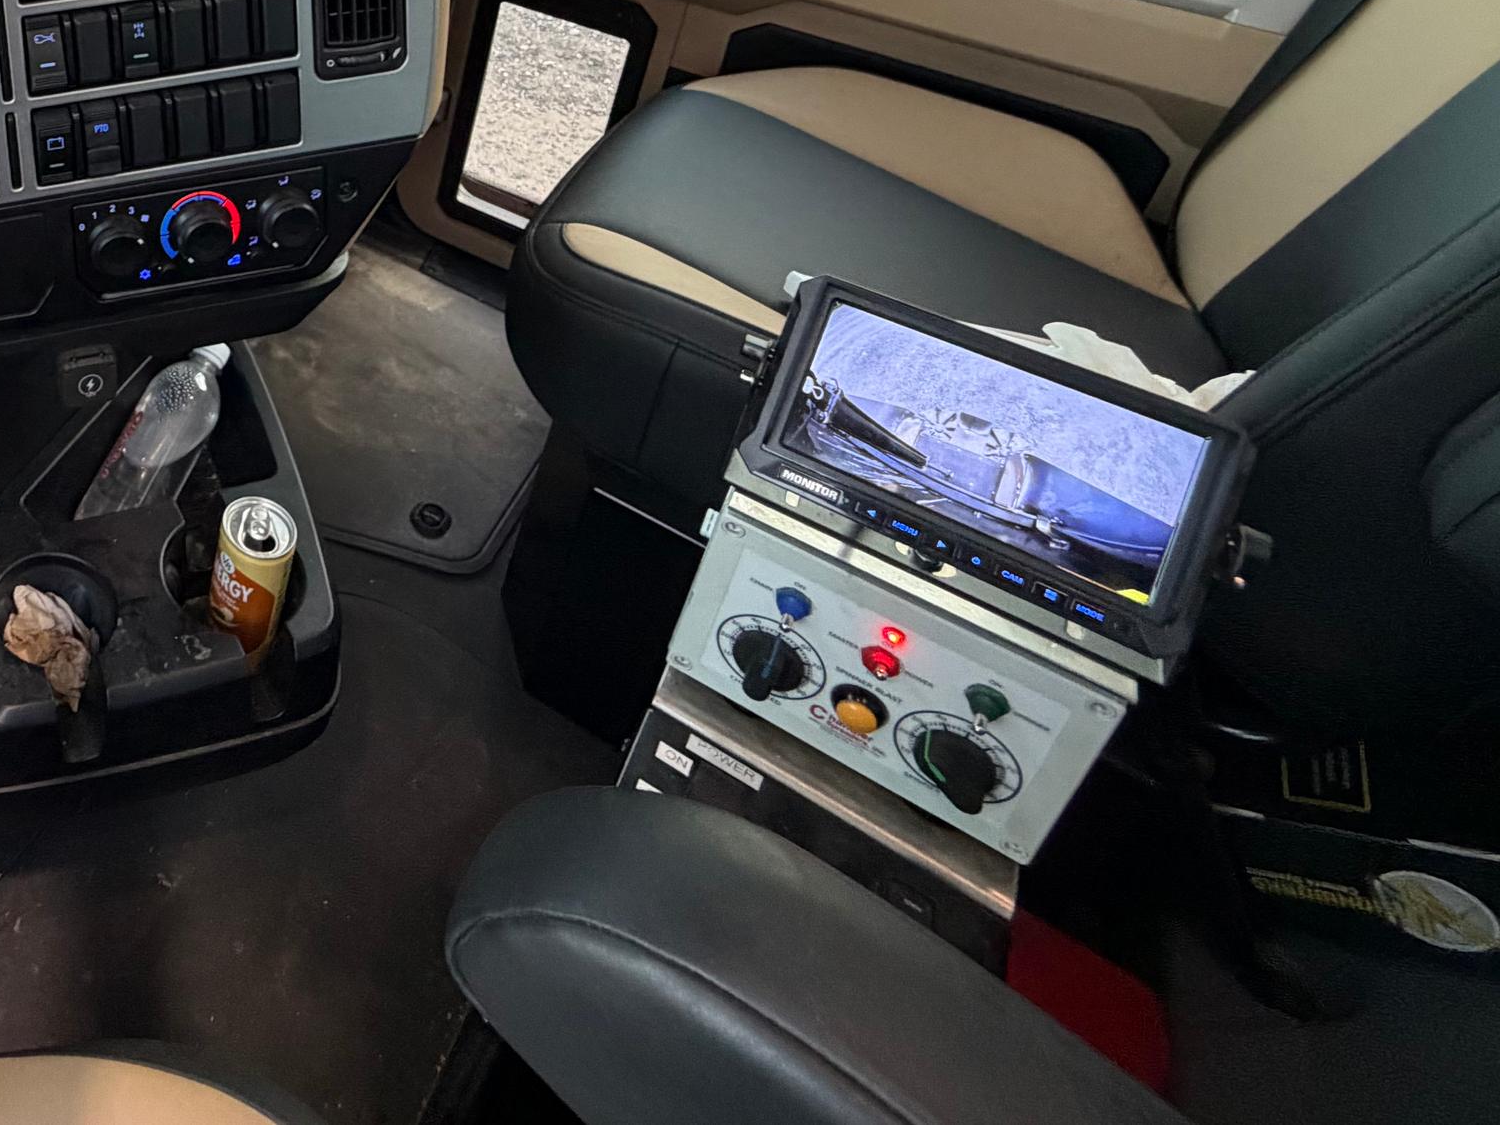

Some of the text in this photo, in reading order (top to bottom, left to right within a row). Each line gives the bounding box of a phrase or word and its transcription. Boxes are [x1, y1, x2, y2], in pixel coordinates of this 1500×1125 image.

[109, 204, 116, 213] 2
[128, 206, 135, 215] 3
[782, 469, 839, 502] MONITOR
[891, 519, 919, 537] MENU
[1001, 569, 1025, 586] CAM
[1075, 603, 1106, 623] MODE
[665, 749, 689, 769] ON
